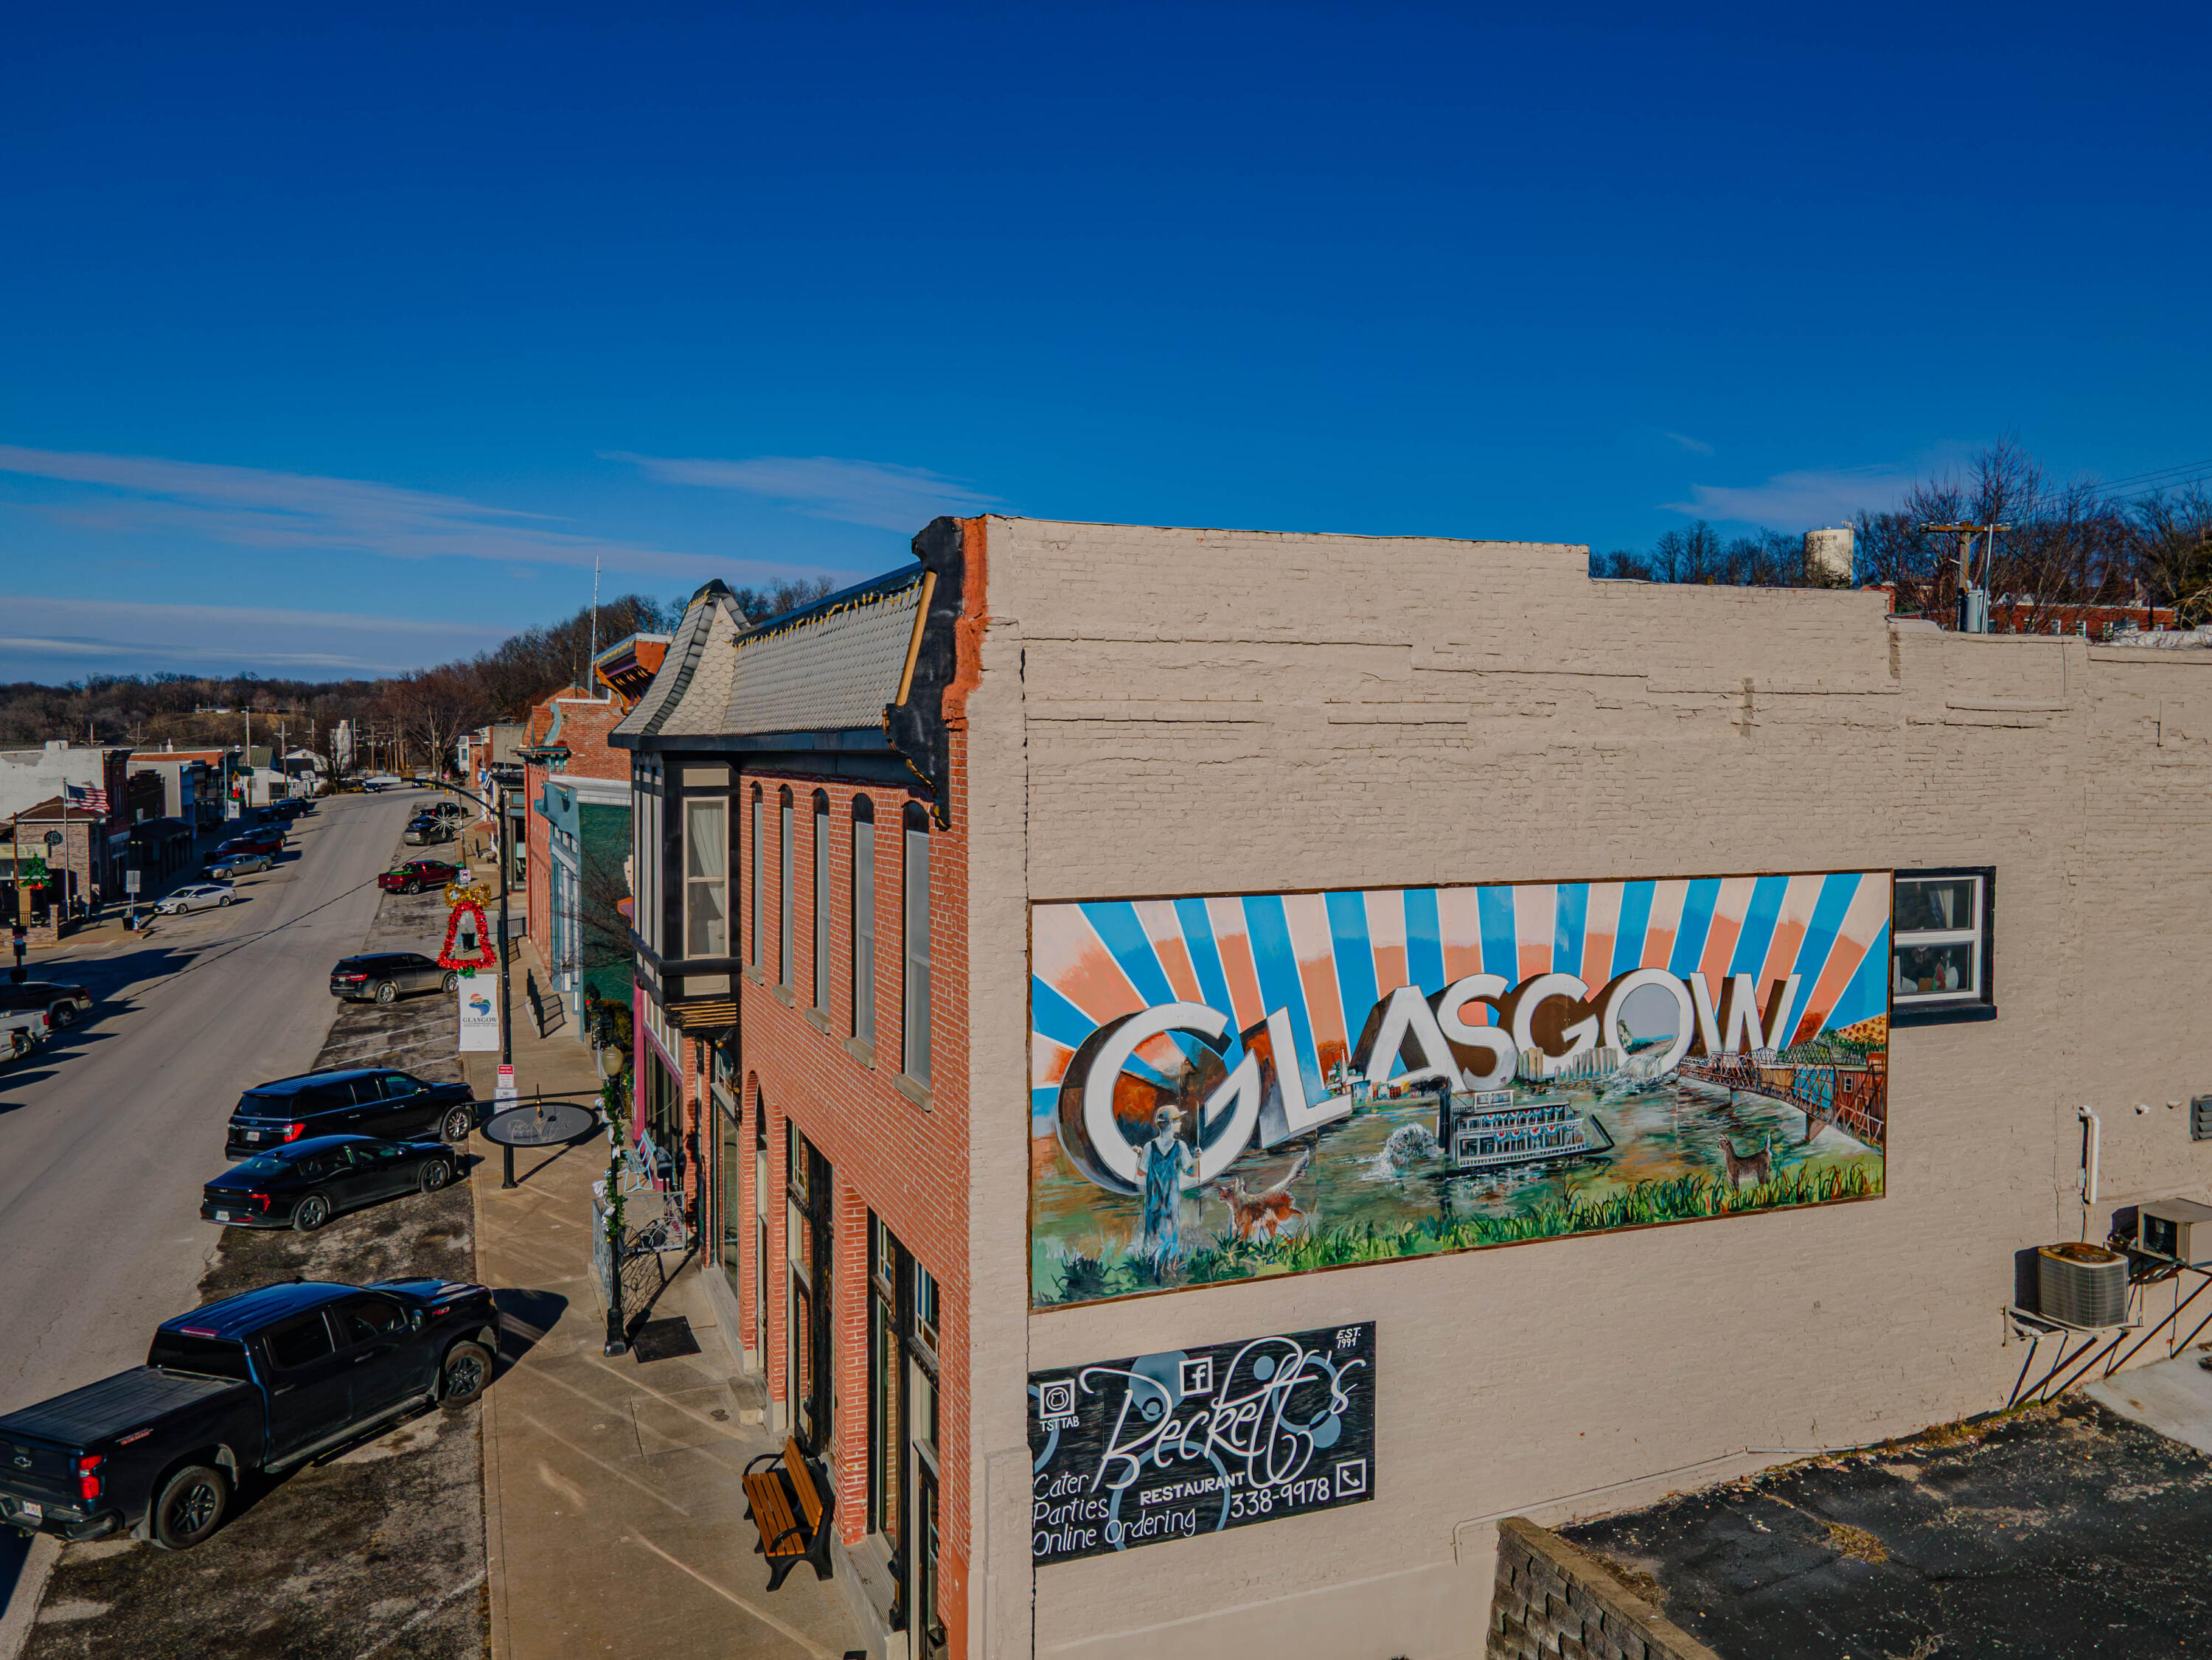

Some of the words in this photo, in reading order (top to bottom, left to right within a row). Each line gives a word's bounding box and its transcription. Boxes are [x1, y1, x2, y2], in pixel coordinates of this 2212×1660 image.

[1065, 968, 1802, 1190] GLASGOW
[1336, 1326, 1362, 1340] EST.
[1079, 1335, 1367, 1494] Beckett's
[1033, 1471, 1089, 1501] Cater
[1139, 1471, 1246, 1506] RESTAURANT
[1231, 1476, 1331, 1519] 338-9978
[1033, 1498, 1110, 1528] Parties
[1033, 1523, 1097, 1557] Online
[1105, 1507, 1197, 1544] Ordering
